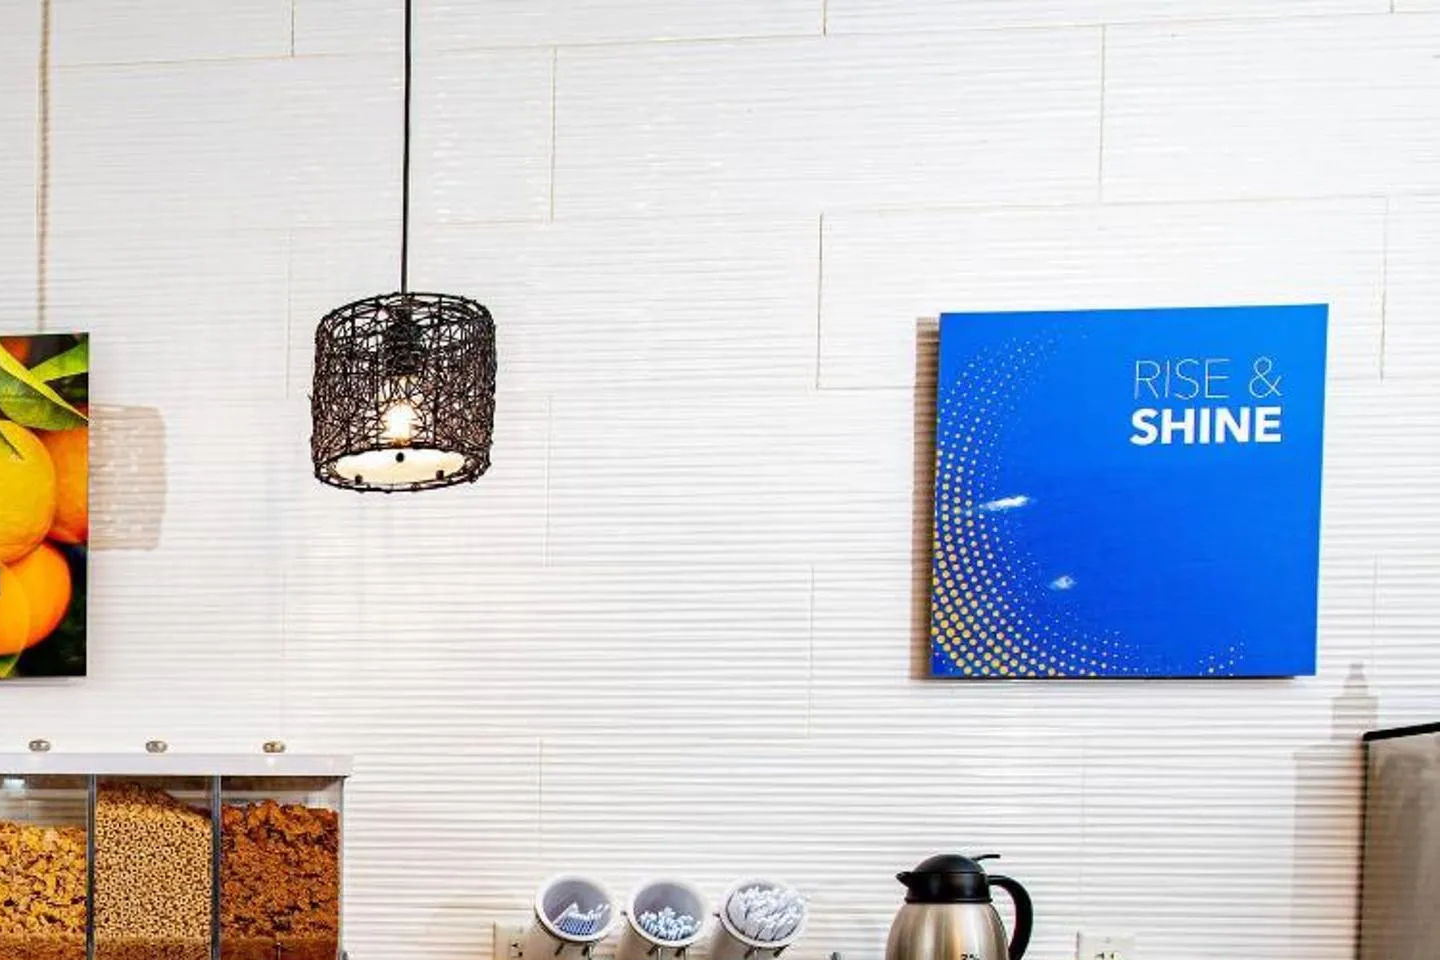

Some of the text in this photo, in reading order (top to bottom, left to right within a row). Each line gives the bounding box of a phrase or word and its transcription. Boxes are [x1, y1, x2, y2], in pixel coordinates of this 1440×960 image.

[1134, 355, 1283, 400] RISE &
[1129, 406, 1283, 446] SHINE
